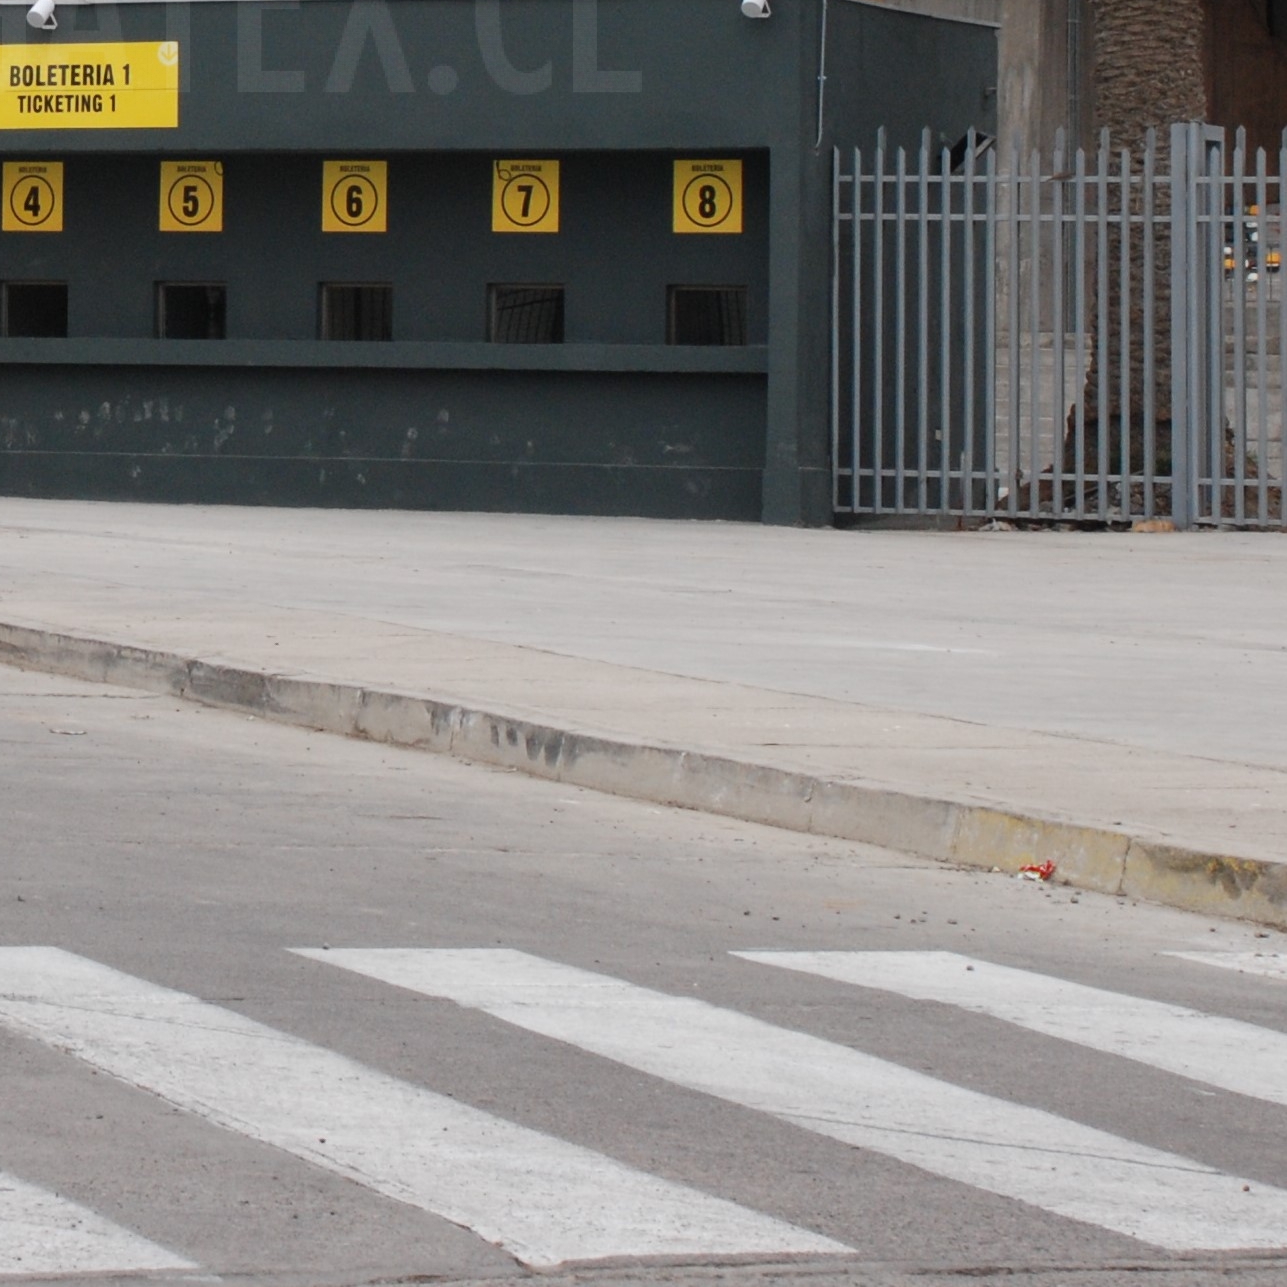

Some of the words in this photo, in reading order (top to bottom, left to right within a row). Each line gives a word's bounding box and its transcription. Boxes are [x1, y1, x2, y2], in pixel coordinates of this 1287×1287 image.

[10, 64, 114, 87] BOLETERIA
[122, 63, 130, 85] 1
[17, 94, 102, 113] TICKETING
[109, 94, 116, 112] 1
[23, 186, 41, 217] 4
[182, 186, 199, 217] 5
[346, 185, 363, 217] 6
[517, 186, 533, 217] 7
[698, 185, 716, 219] 8
